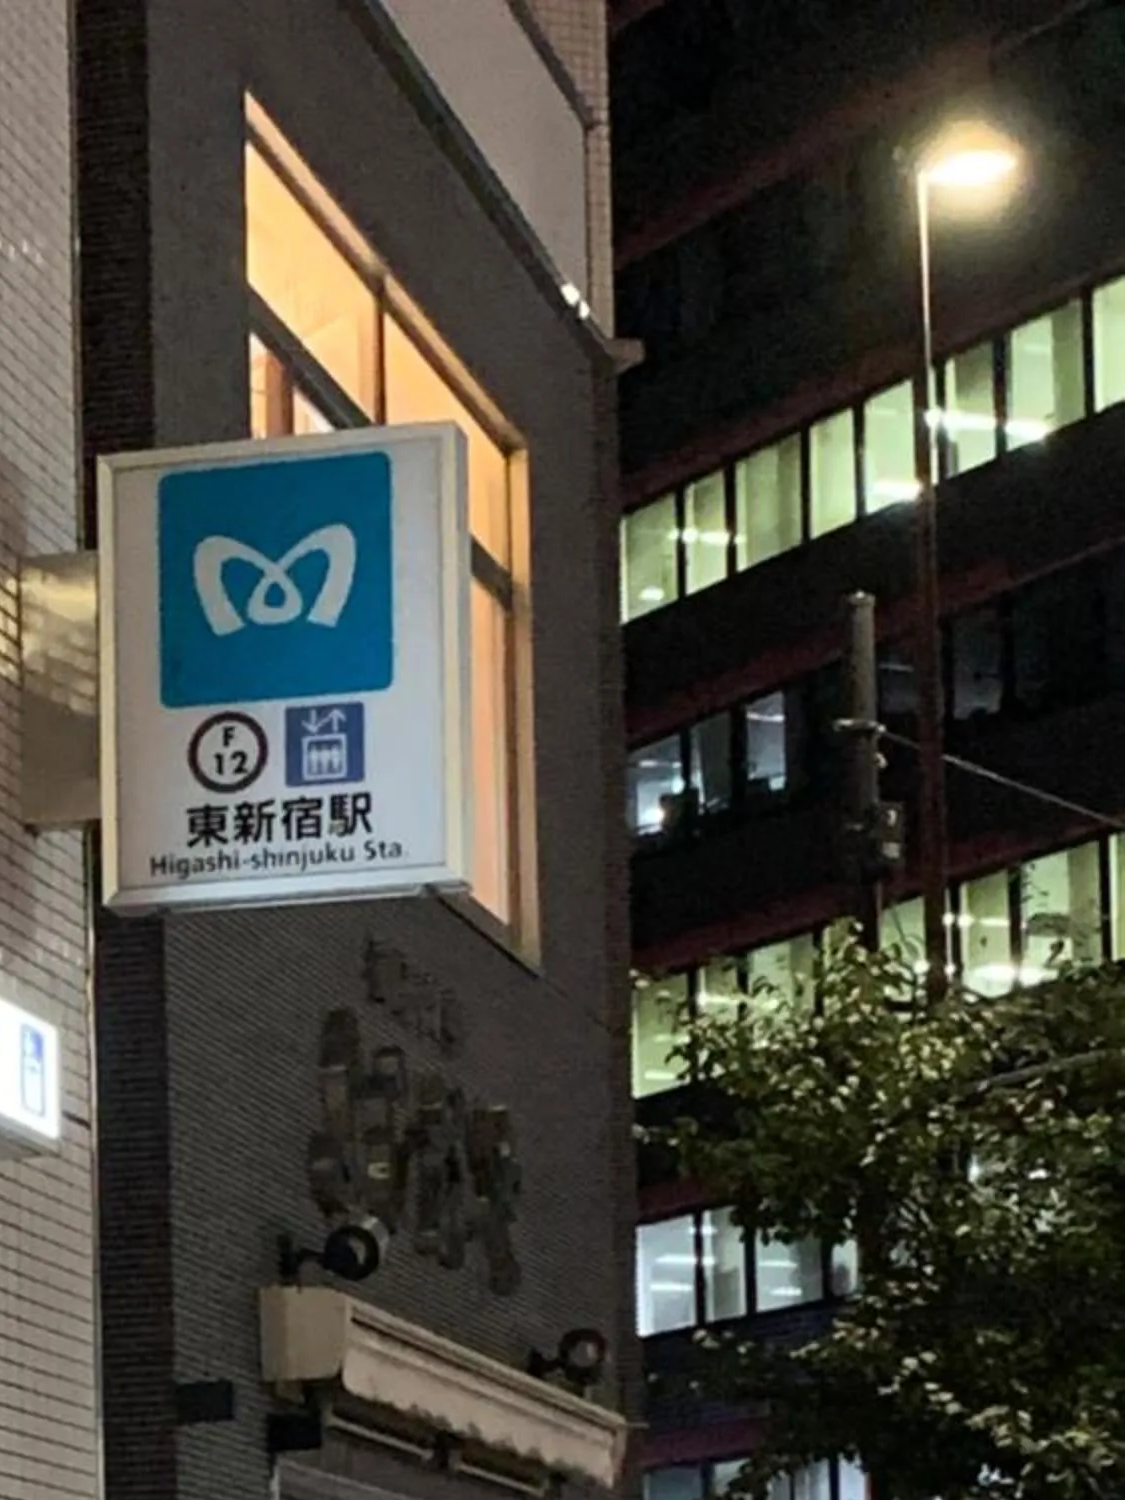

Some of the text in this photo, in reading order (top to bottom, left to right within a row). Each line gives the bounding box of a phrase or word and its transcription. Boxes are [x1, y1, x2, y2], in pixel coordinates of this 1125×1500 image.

[222, 726, 235, 747] F
[213, 751, 248, 775] 12
[186, 792, 373, 848] 東新宿駅
[149, 844, 356, 880] Higashi-shinjuku
